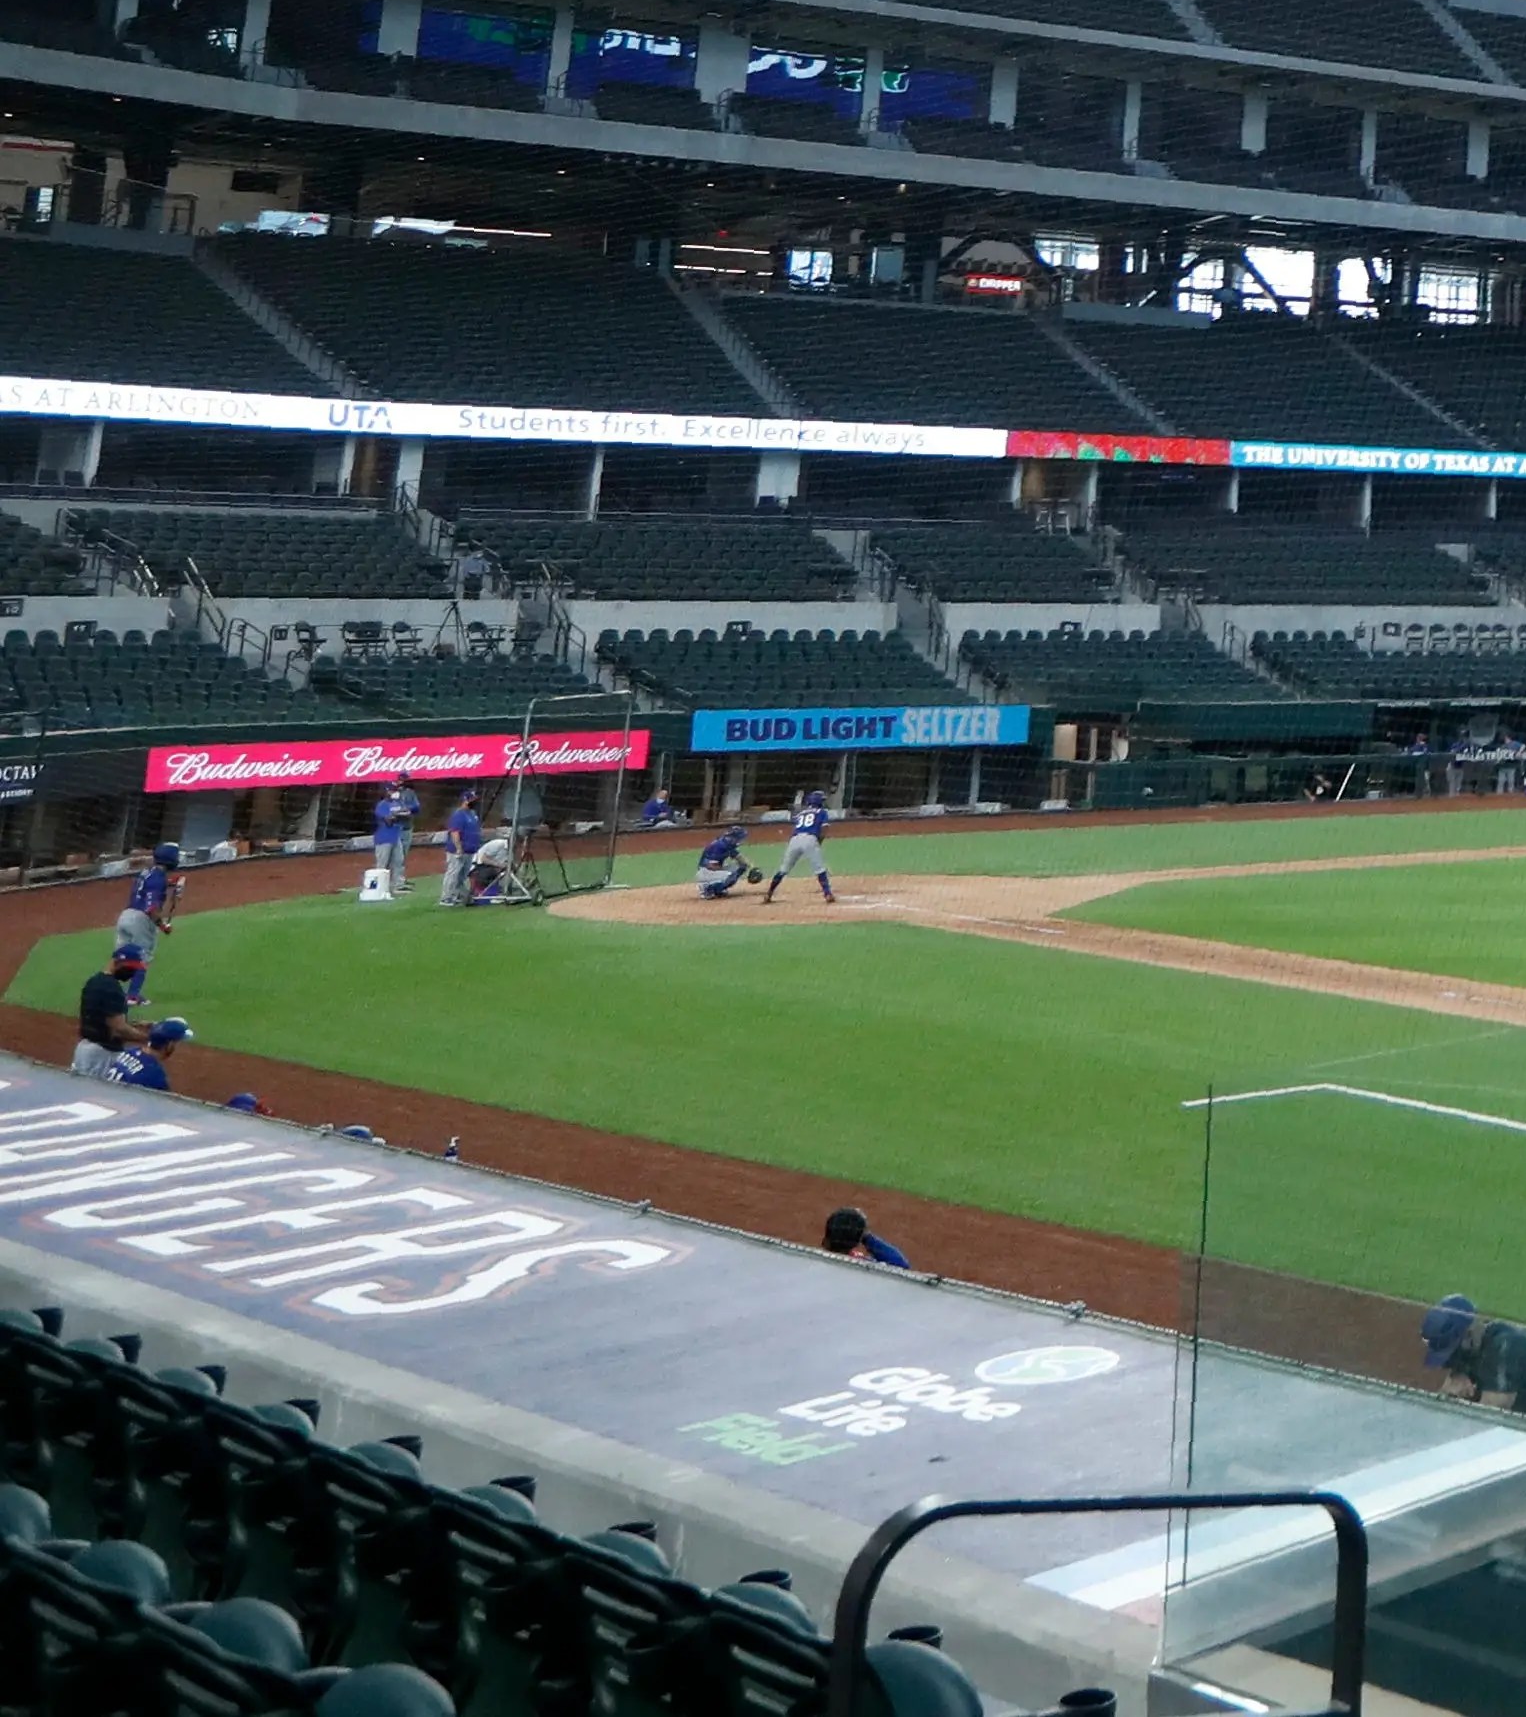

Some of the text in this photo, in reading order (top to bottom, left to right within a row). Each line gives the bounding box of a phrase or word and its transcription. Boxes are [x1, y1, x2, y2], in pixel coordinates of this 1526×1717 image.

[459, 409, 925, 452] Students first. Excellence always
[1244, 445, 1283, 464] THE
[1288, 448, 1400, 469] UNIVERSITY
[1405, 452, 1430, 470] OF
[1433, 453, 1489, 472] TEXAS
[1493, 456, 1516, 473] AT
[726, 706, 1000, 744] BUD LIGHT SELTZER
[167, 752, 323, 785] Budweiser
[343, 746, 485, 778] Budweiser
[504, 739, 632, 771] Budweiser
[849, 1365, 1022, 1423] Globe
[778, 1391, 909, 1437] Life
[676, 1411, 858, 1466] Field
